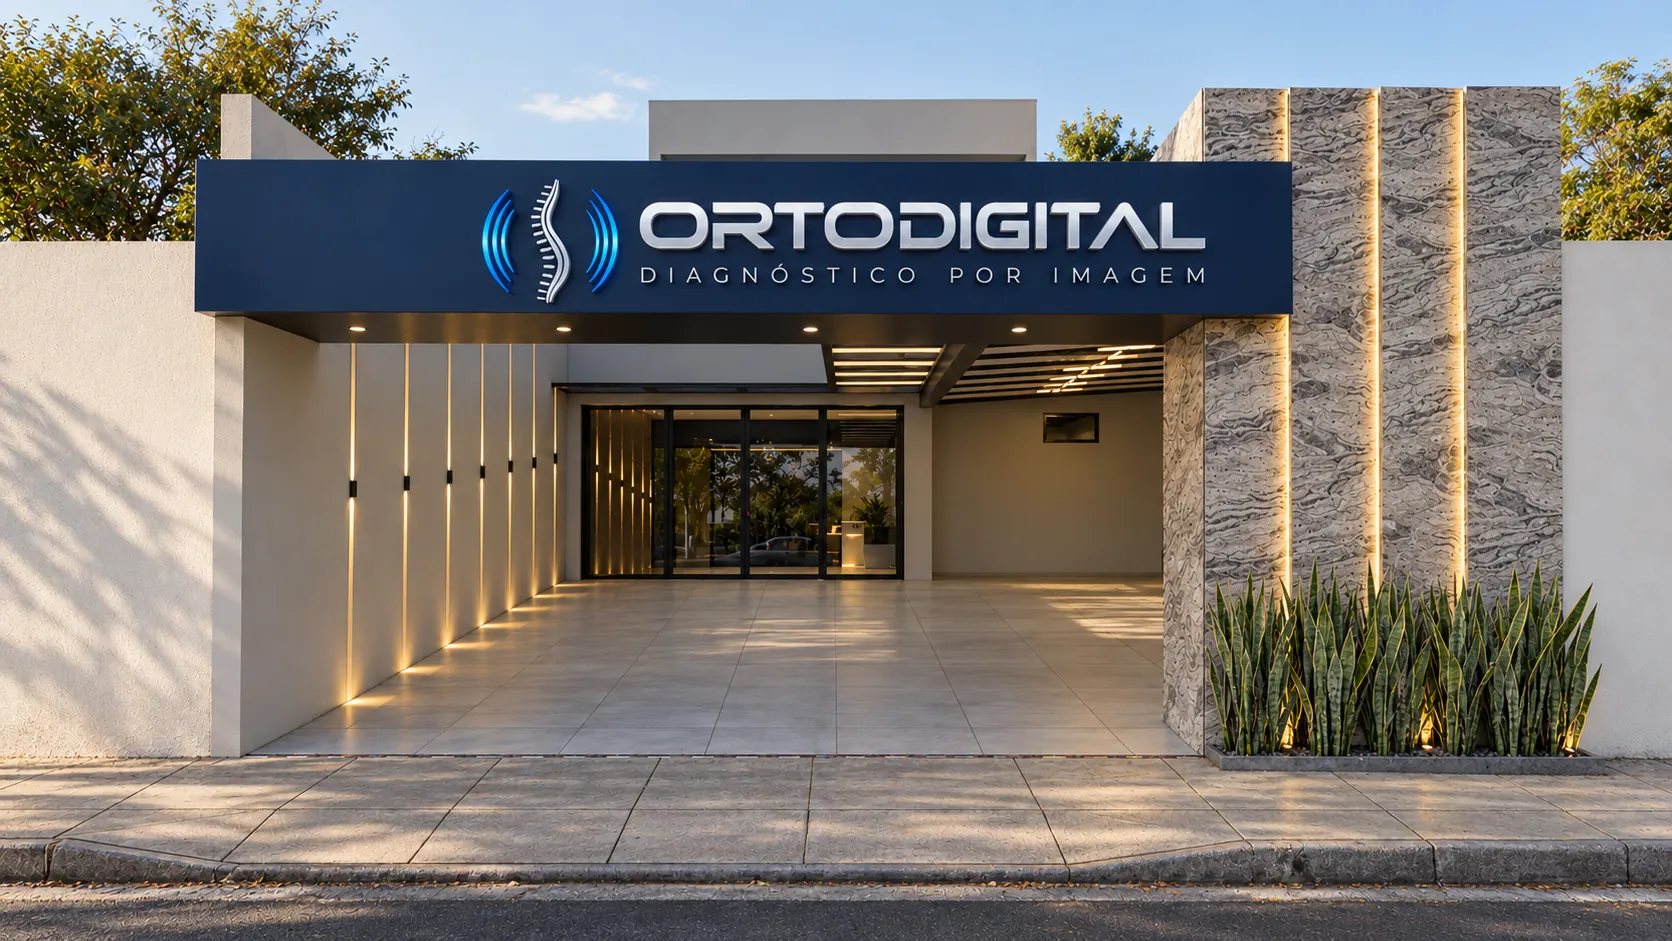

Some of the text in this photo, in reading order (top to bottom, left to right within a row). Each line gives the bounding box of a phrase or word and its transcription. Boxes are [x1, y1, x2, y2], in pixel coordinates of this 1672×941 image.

[639, 201, 1206, 250] ORTODIGITAL
[640, 262, 1207, 284] DIAGNÓSTICO POR IMAGEM
